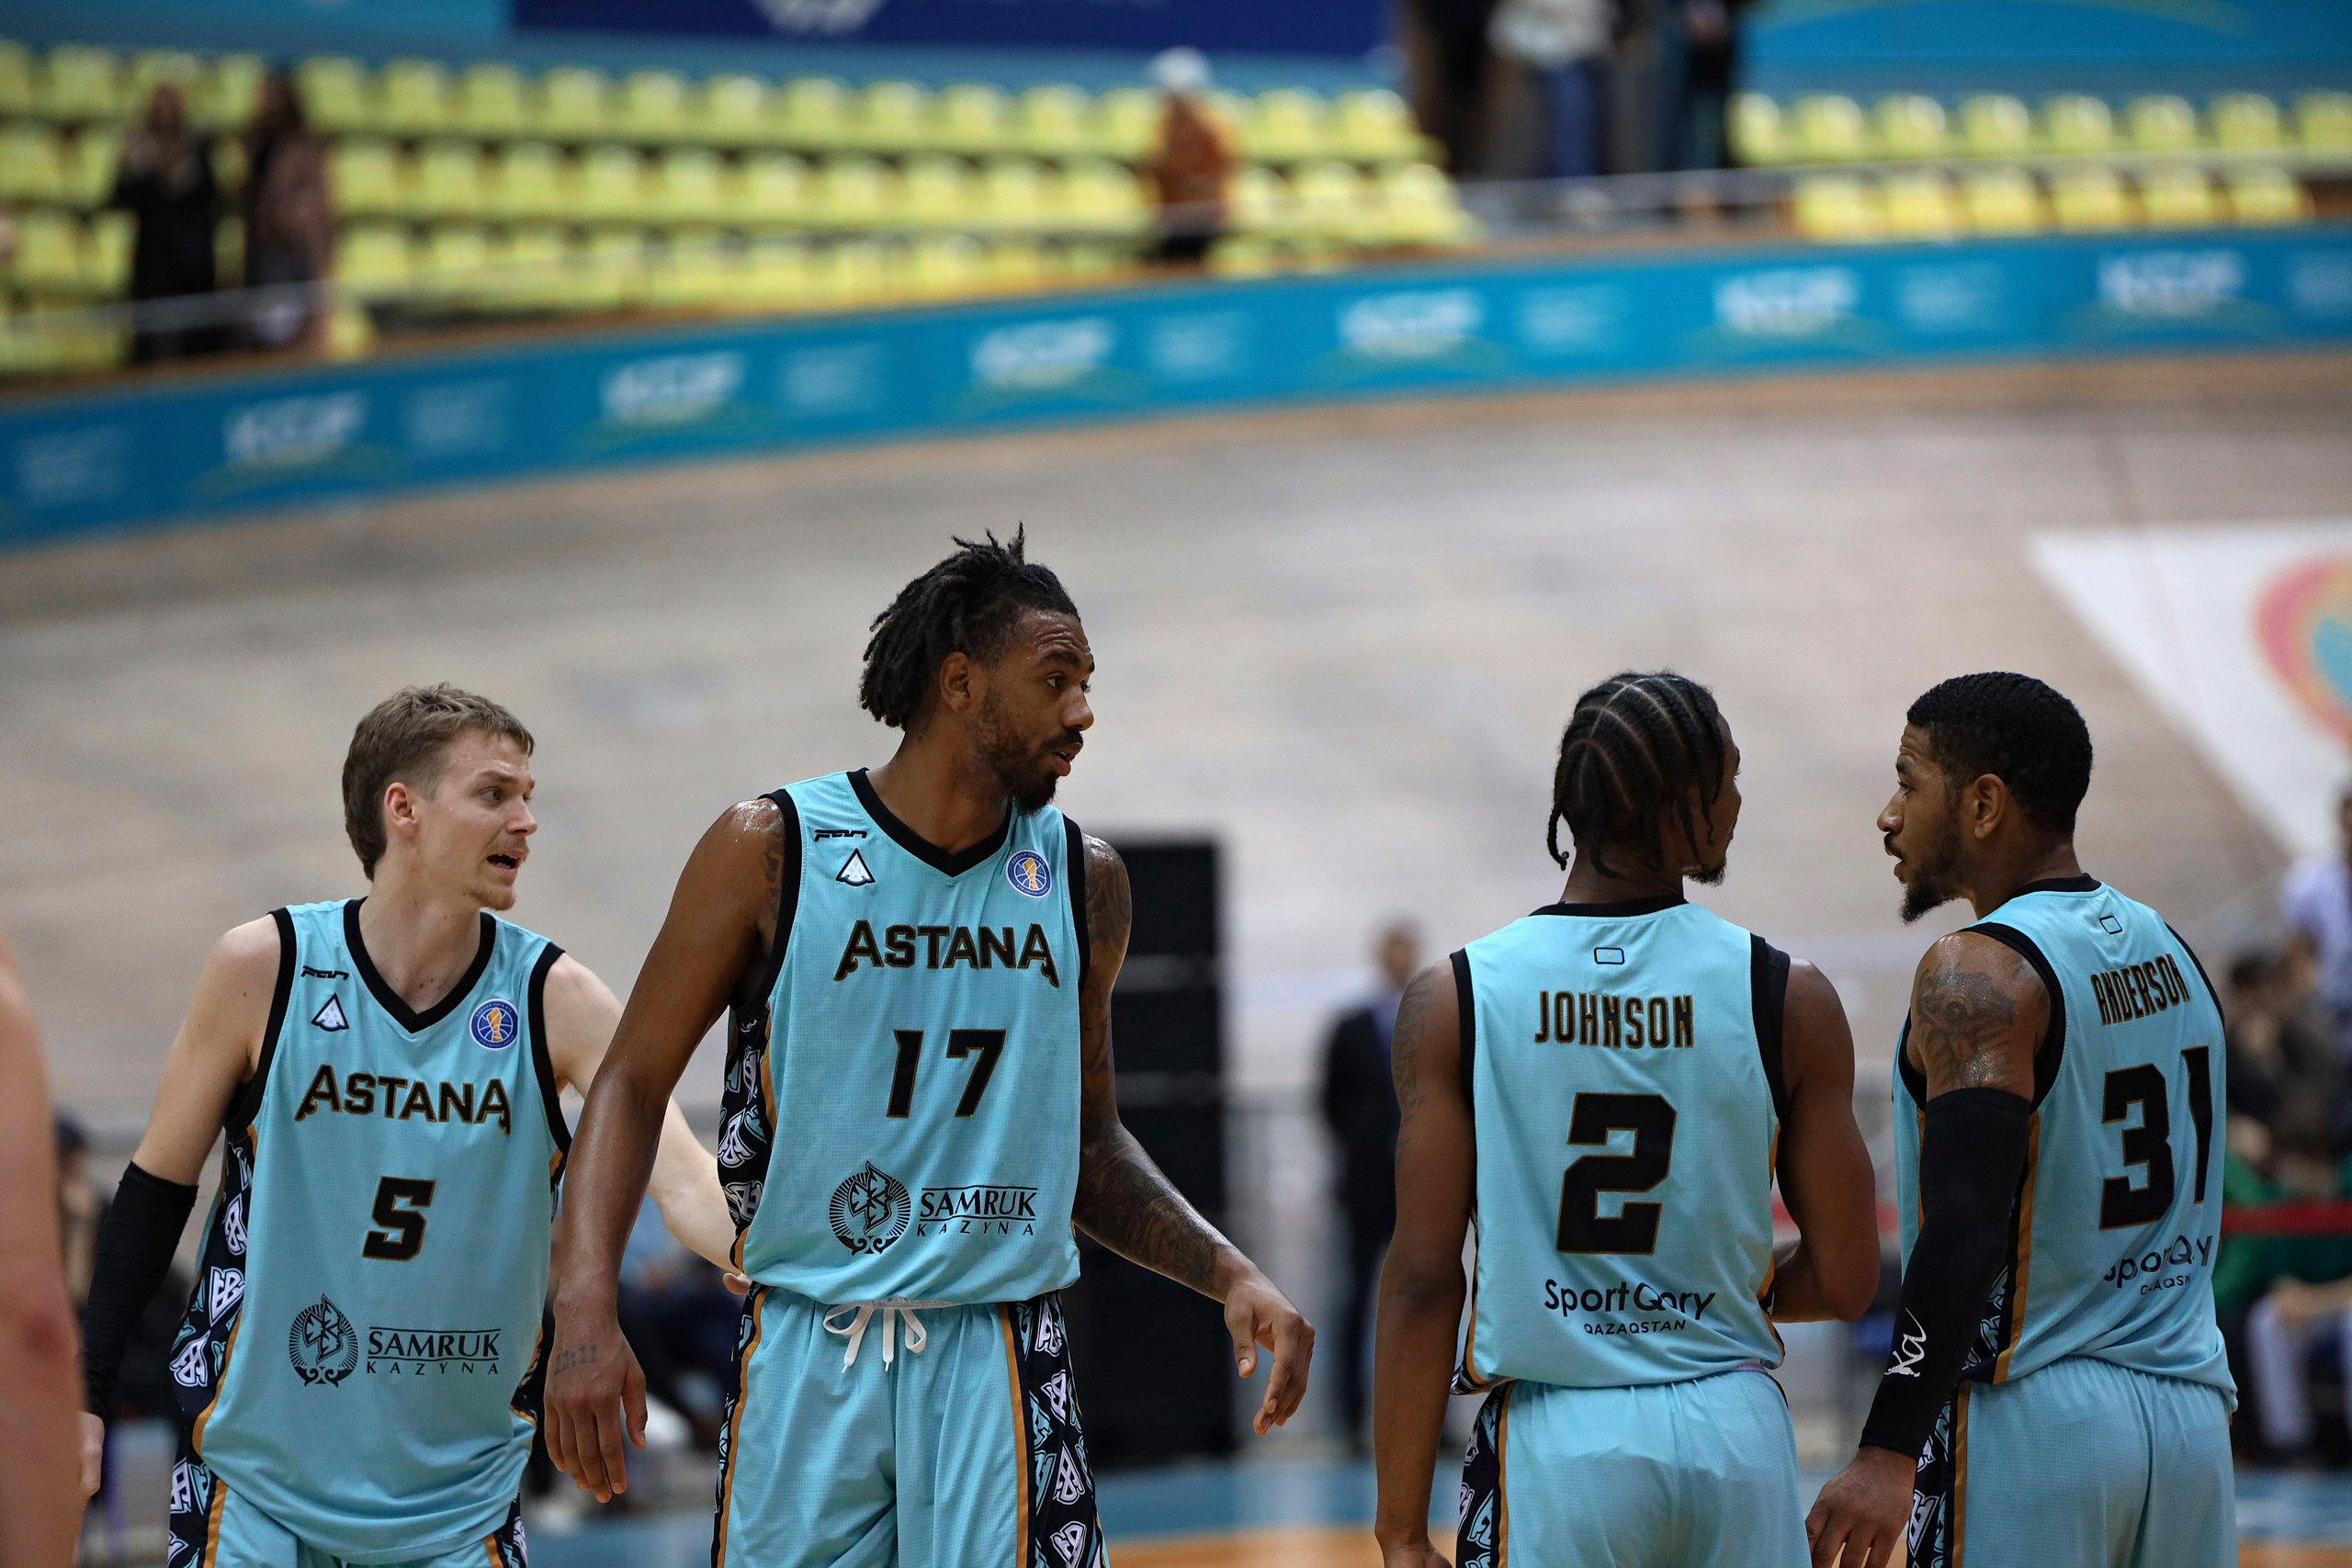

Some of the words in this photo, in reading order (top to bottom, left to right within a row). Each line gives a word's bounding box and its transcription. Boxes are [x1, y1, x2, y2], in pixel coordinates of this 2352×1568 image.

[2090, 953, 2190, 1026] ANDERSON
[1534, 990, 1694, 1049] JOHNSON
[887, 1029, 1006, 1118] 17
[2099, 1045, 2213, 1230] 31
[1557, 1091, 1678, 1255] 2
[362, 1176, 436, 1261] 5
[920, 1190, 1037, 1217] SAMRUK
[917, 1220, 1035, 1236] KAZYNA
[368, 1331, 500, 1358] SAMRUK
[1584, 1320, 1686, 1336] QAZAQSTAN
[367, 1360, 499, 1376] KAZYNA
[554, 1345, 598, 1375] 11:11
